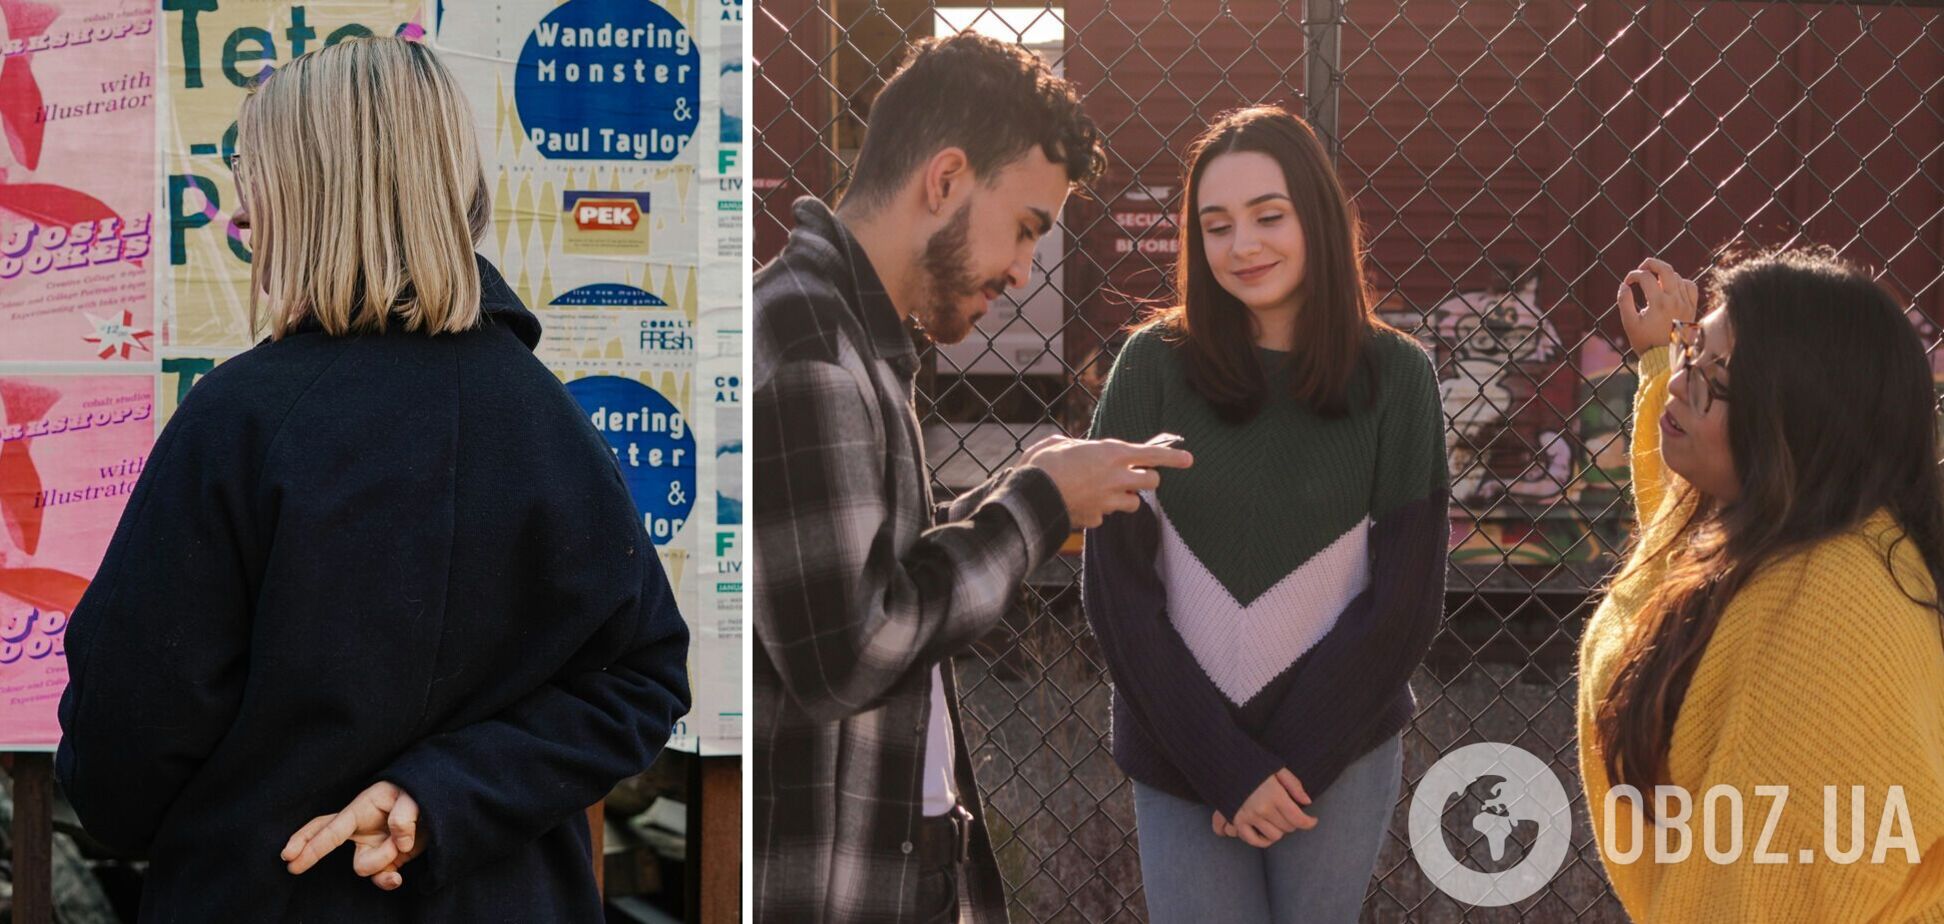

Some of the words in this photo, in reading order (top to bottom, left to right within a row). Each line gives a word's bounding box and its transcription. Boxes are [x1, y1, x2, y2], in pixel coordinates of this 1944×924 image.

[535, 22, 690, 56] Wandering
[101, 71, 151, 94] with
[538, 58, 691, 84] Monster
[34, 94, 152, 124] illustrator
[673, 97, 692, 121] &
[531, 127, 589, 152] Paul
[599, 128, 690, 160] Taylor
[579, 206, 633, 225] PEK
[0, 213, 151, 258] JOSIE
[641, 320, 693, 328] COBALT
[715, 391, 739, 402] AL
[591, 407, 685, 440] dering
[667, 480, 686, 506] &
